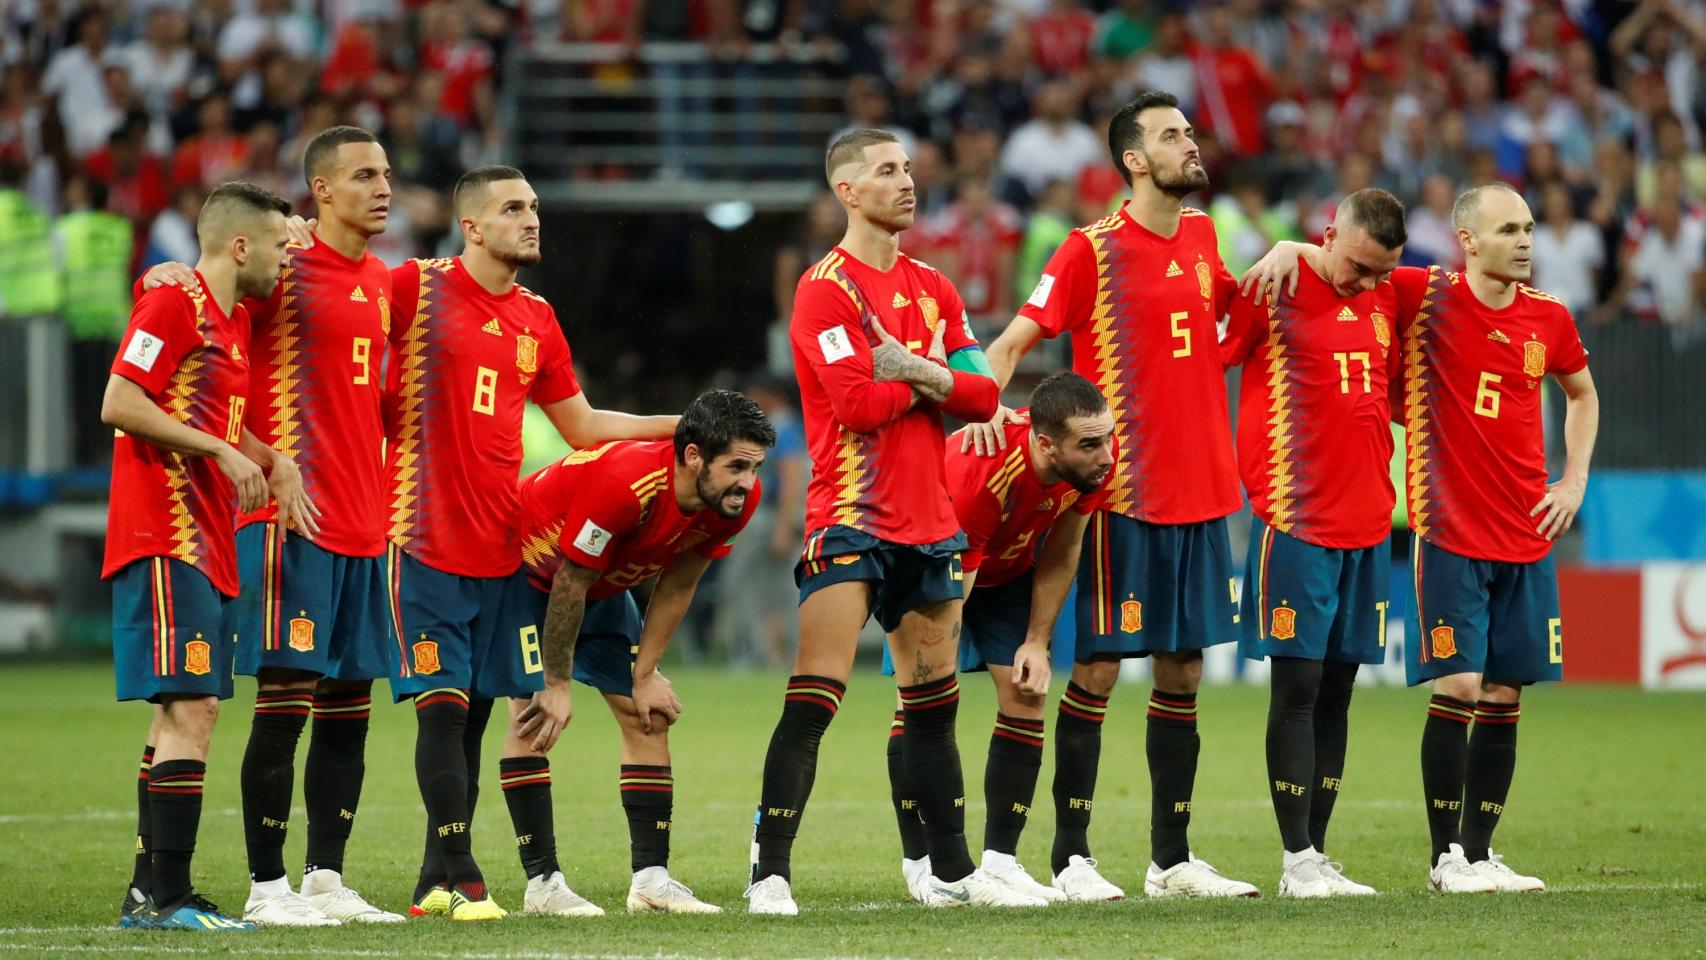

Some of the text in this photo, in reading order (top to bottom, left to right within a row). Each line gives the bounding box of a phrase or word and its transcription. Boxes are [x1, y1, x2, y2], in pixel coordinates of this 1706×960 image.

[1170, 311, 1191, 358] 5
[353, 337, 371, 385] 9
[1334, 352, 1370, 394] 17
[473, 366, 499, 416] 8
[1474, 371, 1503, 419] 6
[225, 395, 246, 444] 18
[519, 624, 544, 675] 8
